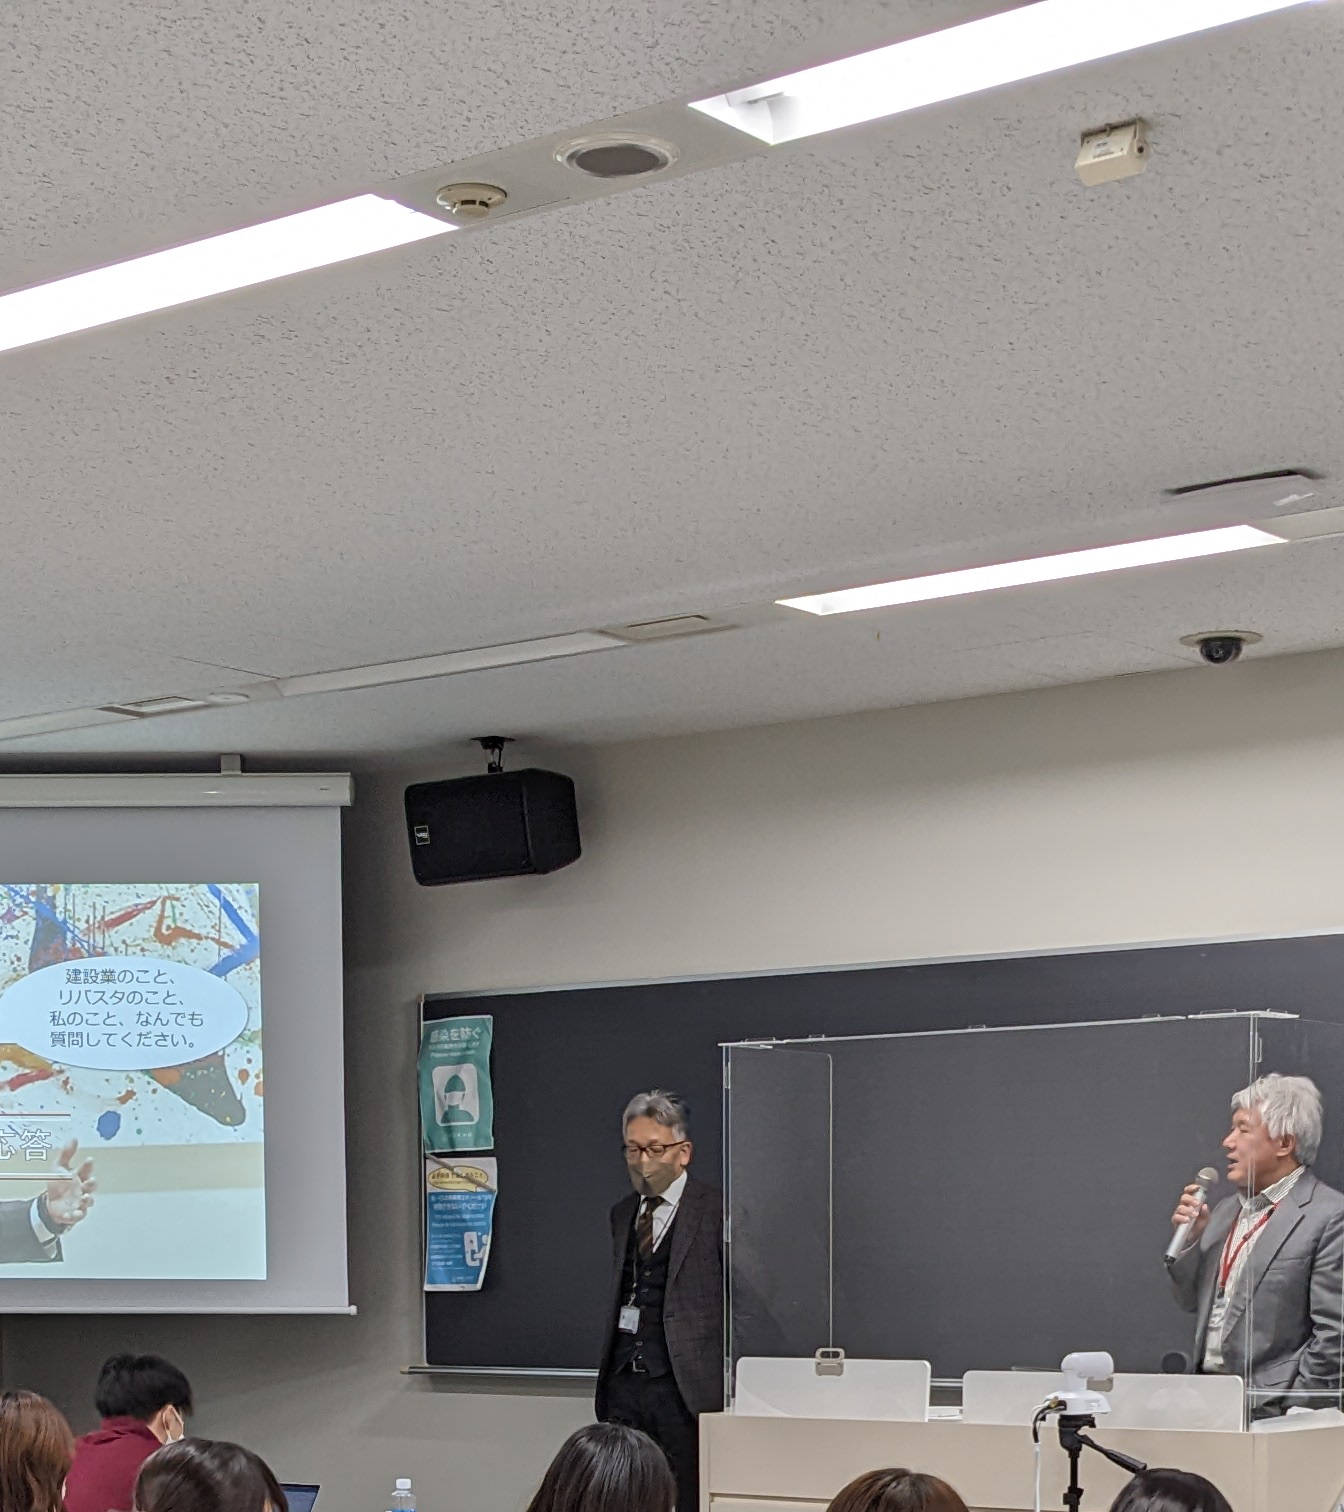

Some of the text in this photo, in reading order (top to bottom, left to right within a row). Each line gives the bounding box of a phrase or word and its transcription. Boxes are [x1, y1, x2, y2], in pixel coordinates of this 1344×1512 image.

[65, 968, 175, 985] 建設業のこと、
[59, 989, 184, 1006] リバスタのこと、
[49, 1010, 204, 1027] 私のこと、なんでも
[50, 1031, 194, 1048] 質問してください。
